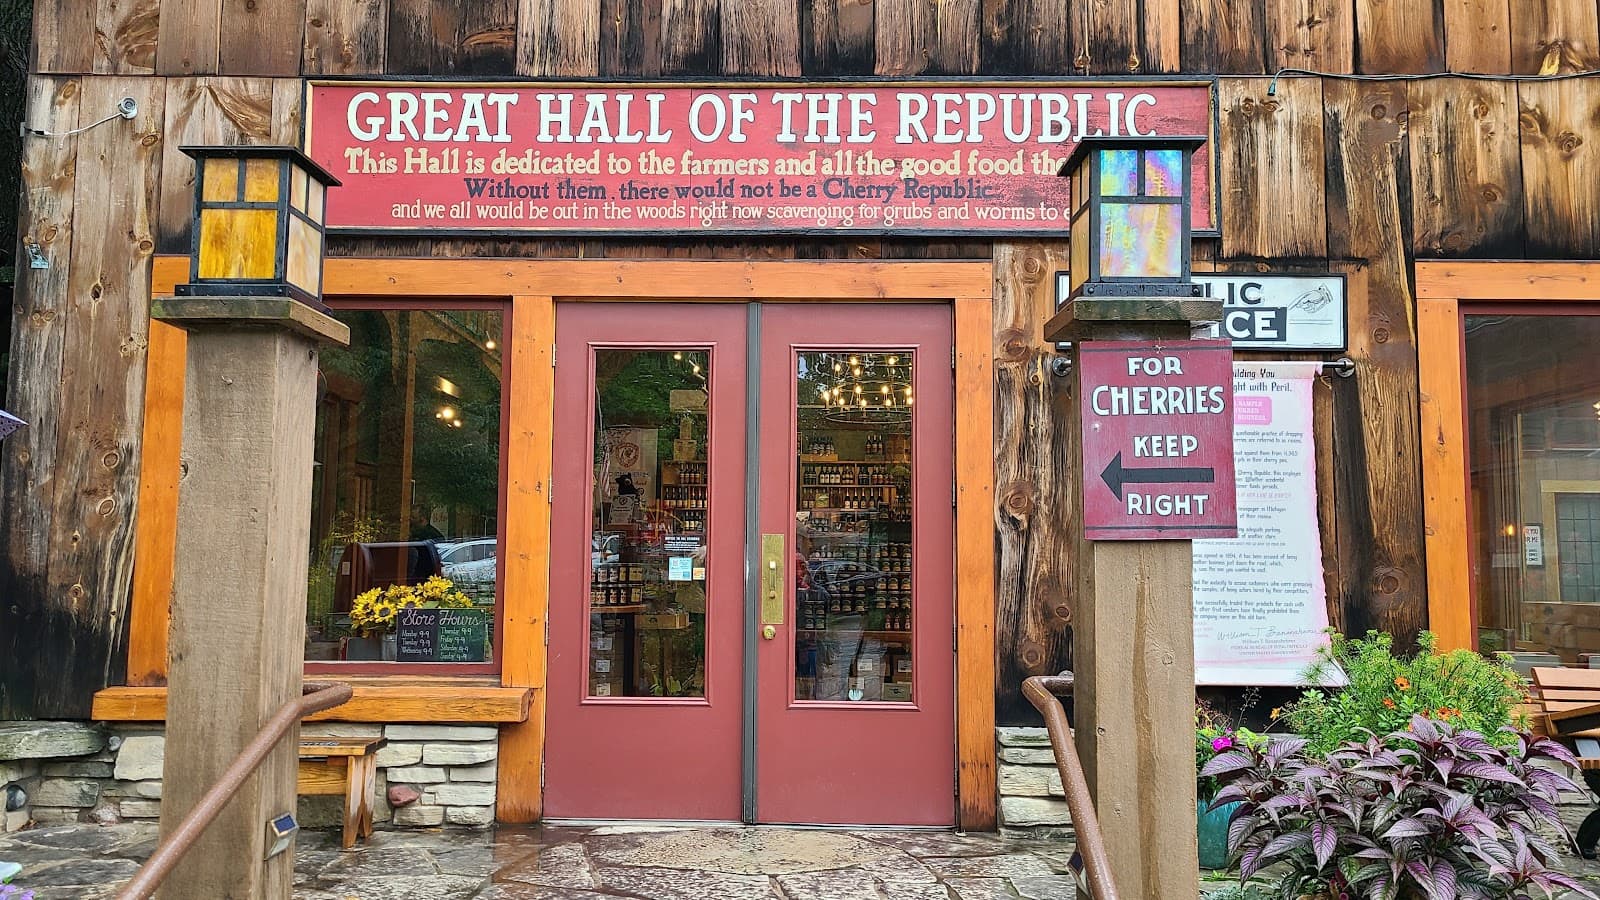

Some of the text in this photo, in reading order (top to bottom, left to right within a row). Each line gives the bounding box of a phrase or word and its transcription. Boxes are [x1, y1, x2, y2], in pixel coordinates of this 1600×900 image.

[347, 92, 1157, 144] GREAT HALL OF THE REPUBLIC
[344, 148, 398, 174] This
[403, 148, 460, 174] Hall
[465, 151, 486, 175] is
[490, 150, 600, 175] dedicated
[607, 152, 632, 175] to
[638, 149, 676, 175] the
[681, 150, 768, 176] farmers
[774, 150, 816, 176] and
[822, 150, 853, 176] all
[853, 150, 896, 176] the
[901, 149, 964, 182] good
[968, 150, 1025, 176] food
[464, 177, 550, 200] Without
[619, 180, 669, 200] there
[675, 177, 734, 200] would
[740, 180, 775, 201] not
[778, 177, 803, 200] be
[806, 184, 816, 200] a
[822, 178, 898, 204] Cherry
[391, 200, 420, 220] and
[422, 204, 446, 220] we
[449, 201, 471, 220] all
[477, 201, 524, 220] would
[529, 200, 549, 220] be
[552, 202, 579, 220] out
[583, 203, 599, 219] in
[602, 202, 632, 219] the
[636, 200, 687, 220] woods
[690, 200, 729, 226] right
[732, 205, 766, 220] now
[767, 204, 854, 227] scavenging
[859, 202, 881, 220] for
[883, 201, 932, 226] grubs
[937, 202, 970, 220] and
[974, 206, 1035, 220] worms
[1040, 201, 1059, 220] to
[1205, 282, 1264, 304] LIC
[1211, 311, 1278, 339] ICE
[1127, 356, 1184, 376] FOR
[1249, 381, 1268, 392] with
[1091, 384, 1226, 416] CHERRIES
[1133, 434, 1199, 458] KEEP
[1126, 493, 1210, 516] RIGHT
[402, 609, 482, 626] Store Hours
